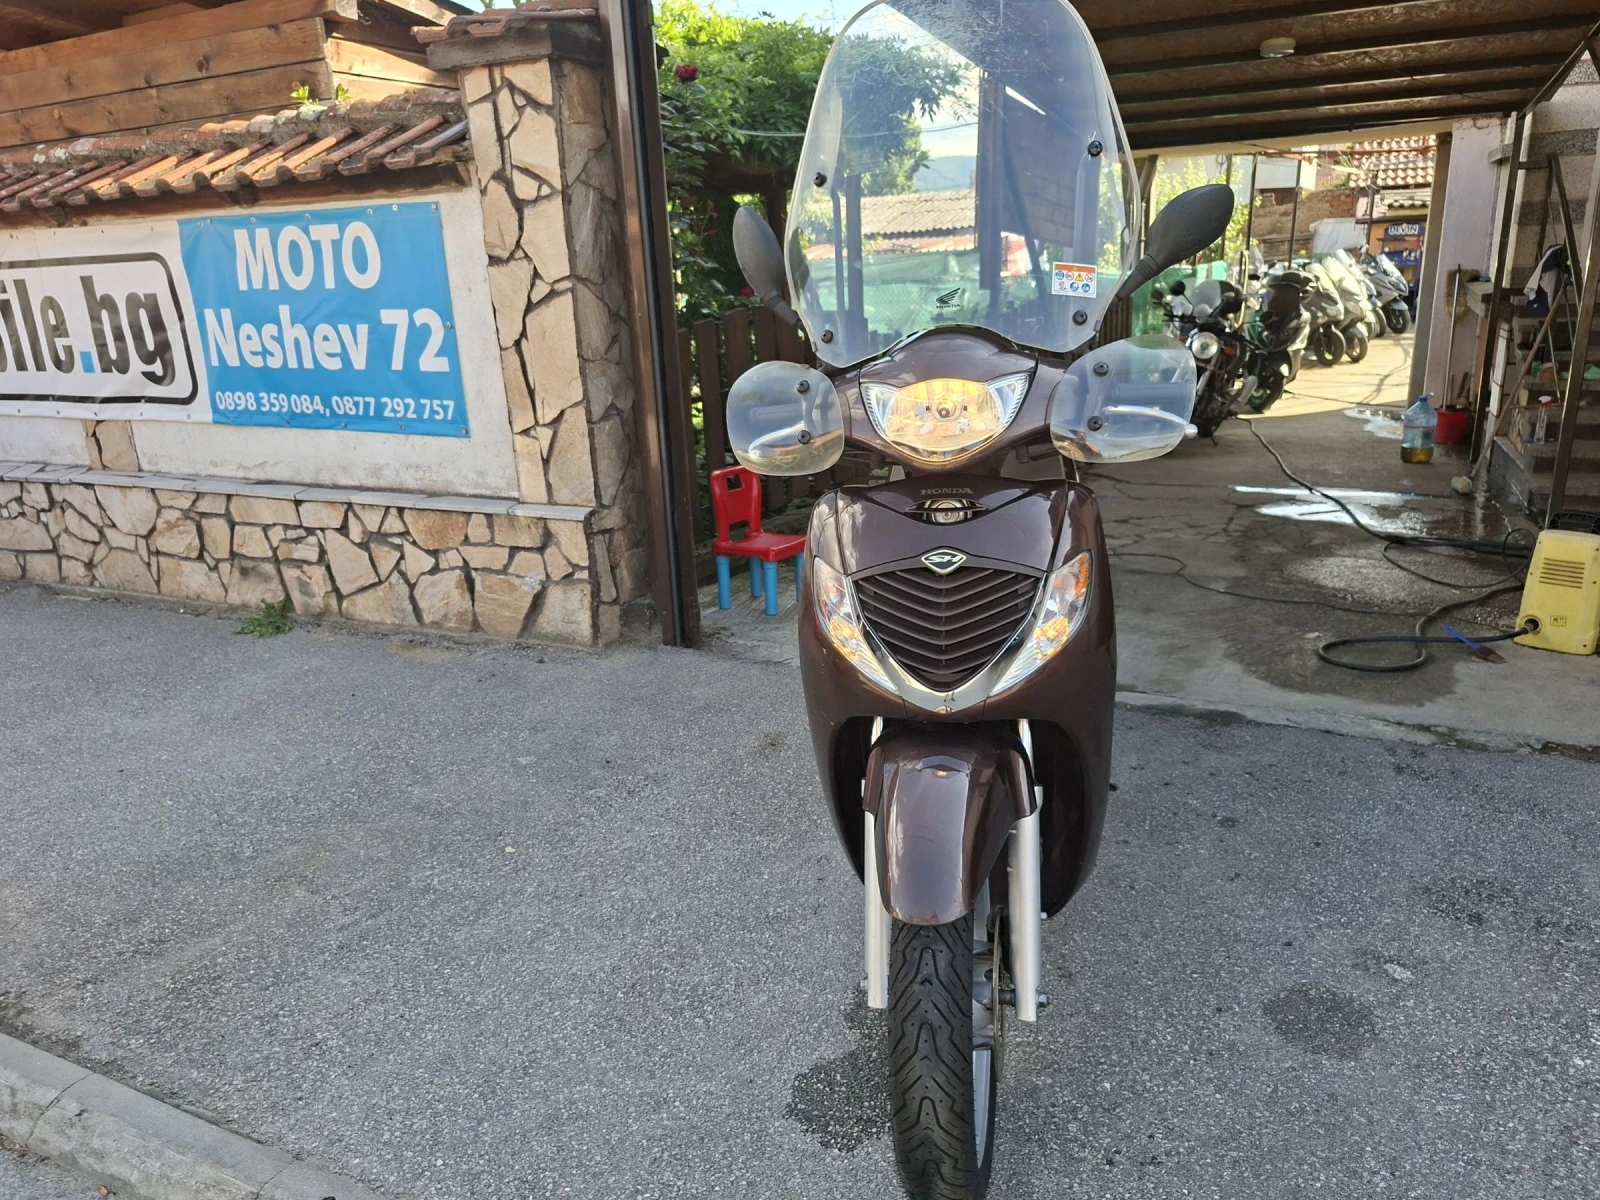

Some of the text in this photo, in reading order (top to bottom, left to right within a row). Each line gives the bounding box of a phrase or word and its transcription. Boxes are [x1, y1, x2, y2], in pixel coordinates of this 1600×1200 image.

[233, 221, 381, 291] MOTO
[0, 275, 176, 387] ile.bg
[203, 304, 450, 372] Neshev 72
[215, 391, 455, 420] 0898 359 084, 0877 292 757
[920, 487, 975, 495] HONDA
[926, 554, 963, 563] SH
